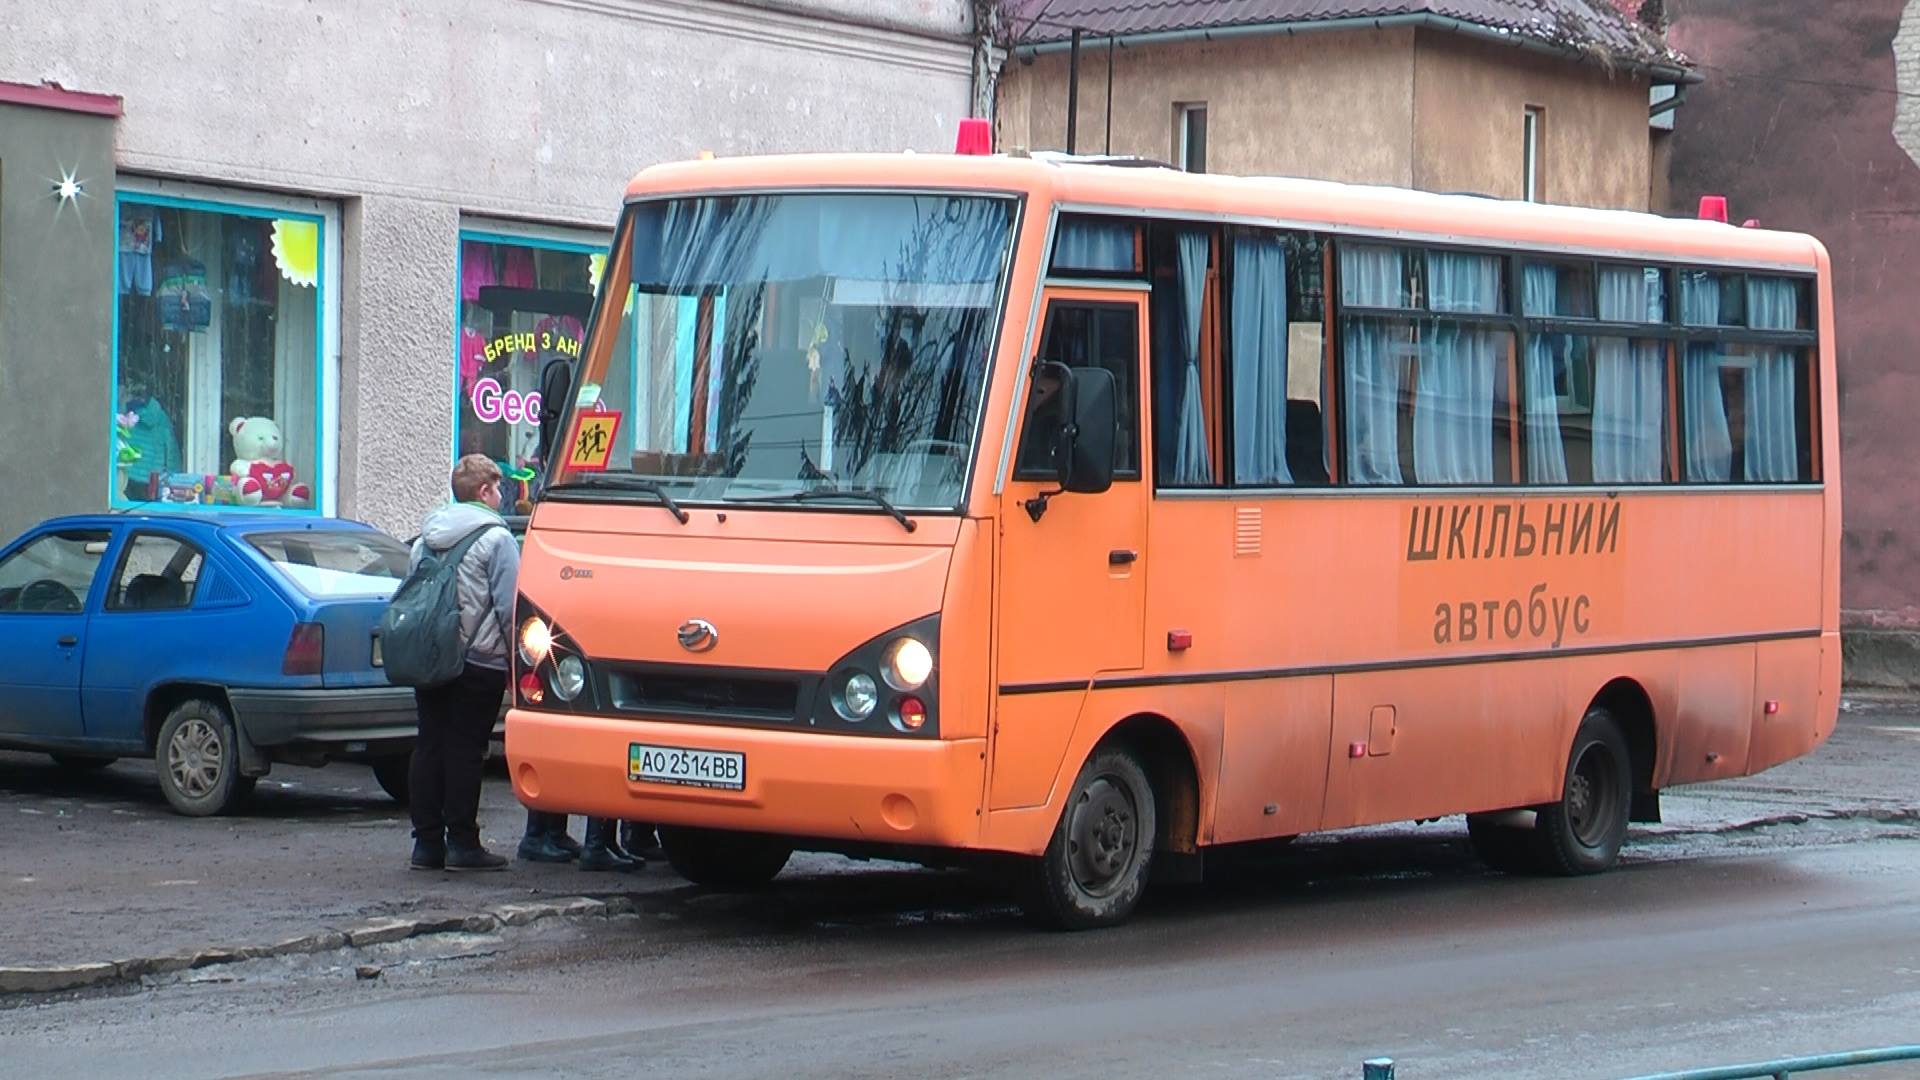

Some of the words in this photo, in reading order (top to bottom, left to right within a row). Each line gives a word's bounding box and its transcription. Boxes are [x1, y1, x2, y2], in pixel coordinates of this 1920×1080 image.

[484, 333, 536, 362] БРЕНД
[1407, 491, 1621, 561] ШКІЛЬНИЙ
[1434, 583, 1590, 648] автобус
[670, 753, 709, 776] 2514
